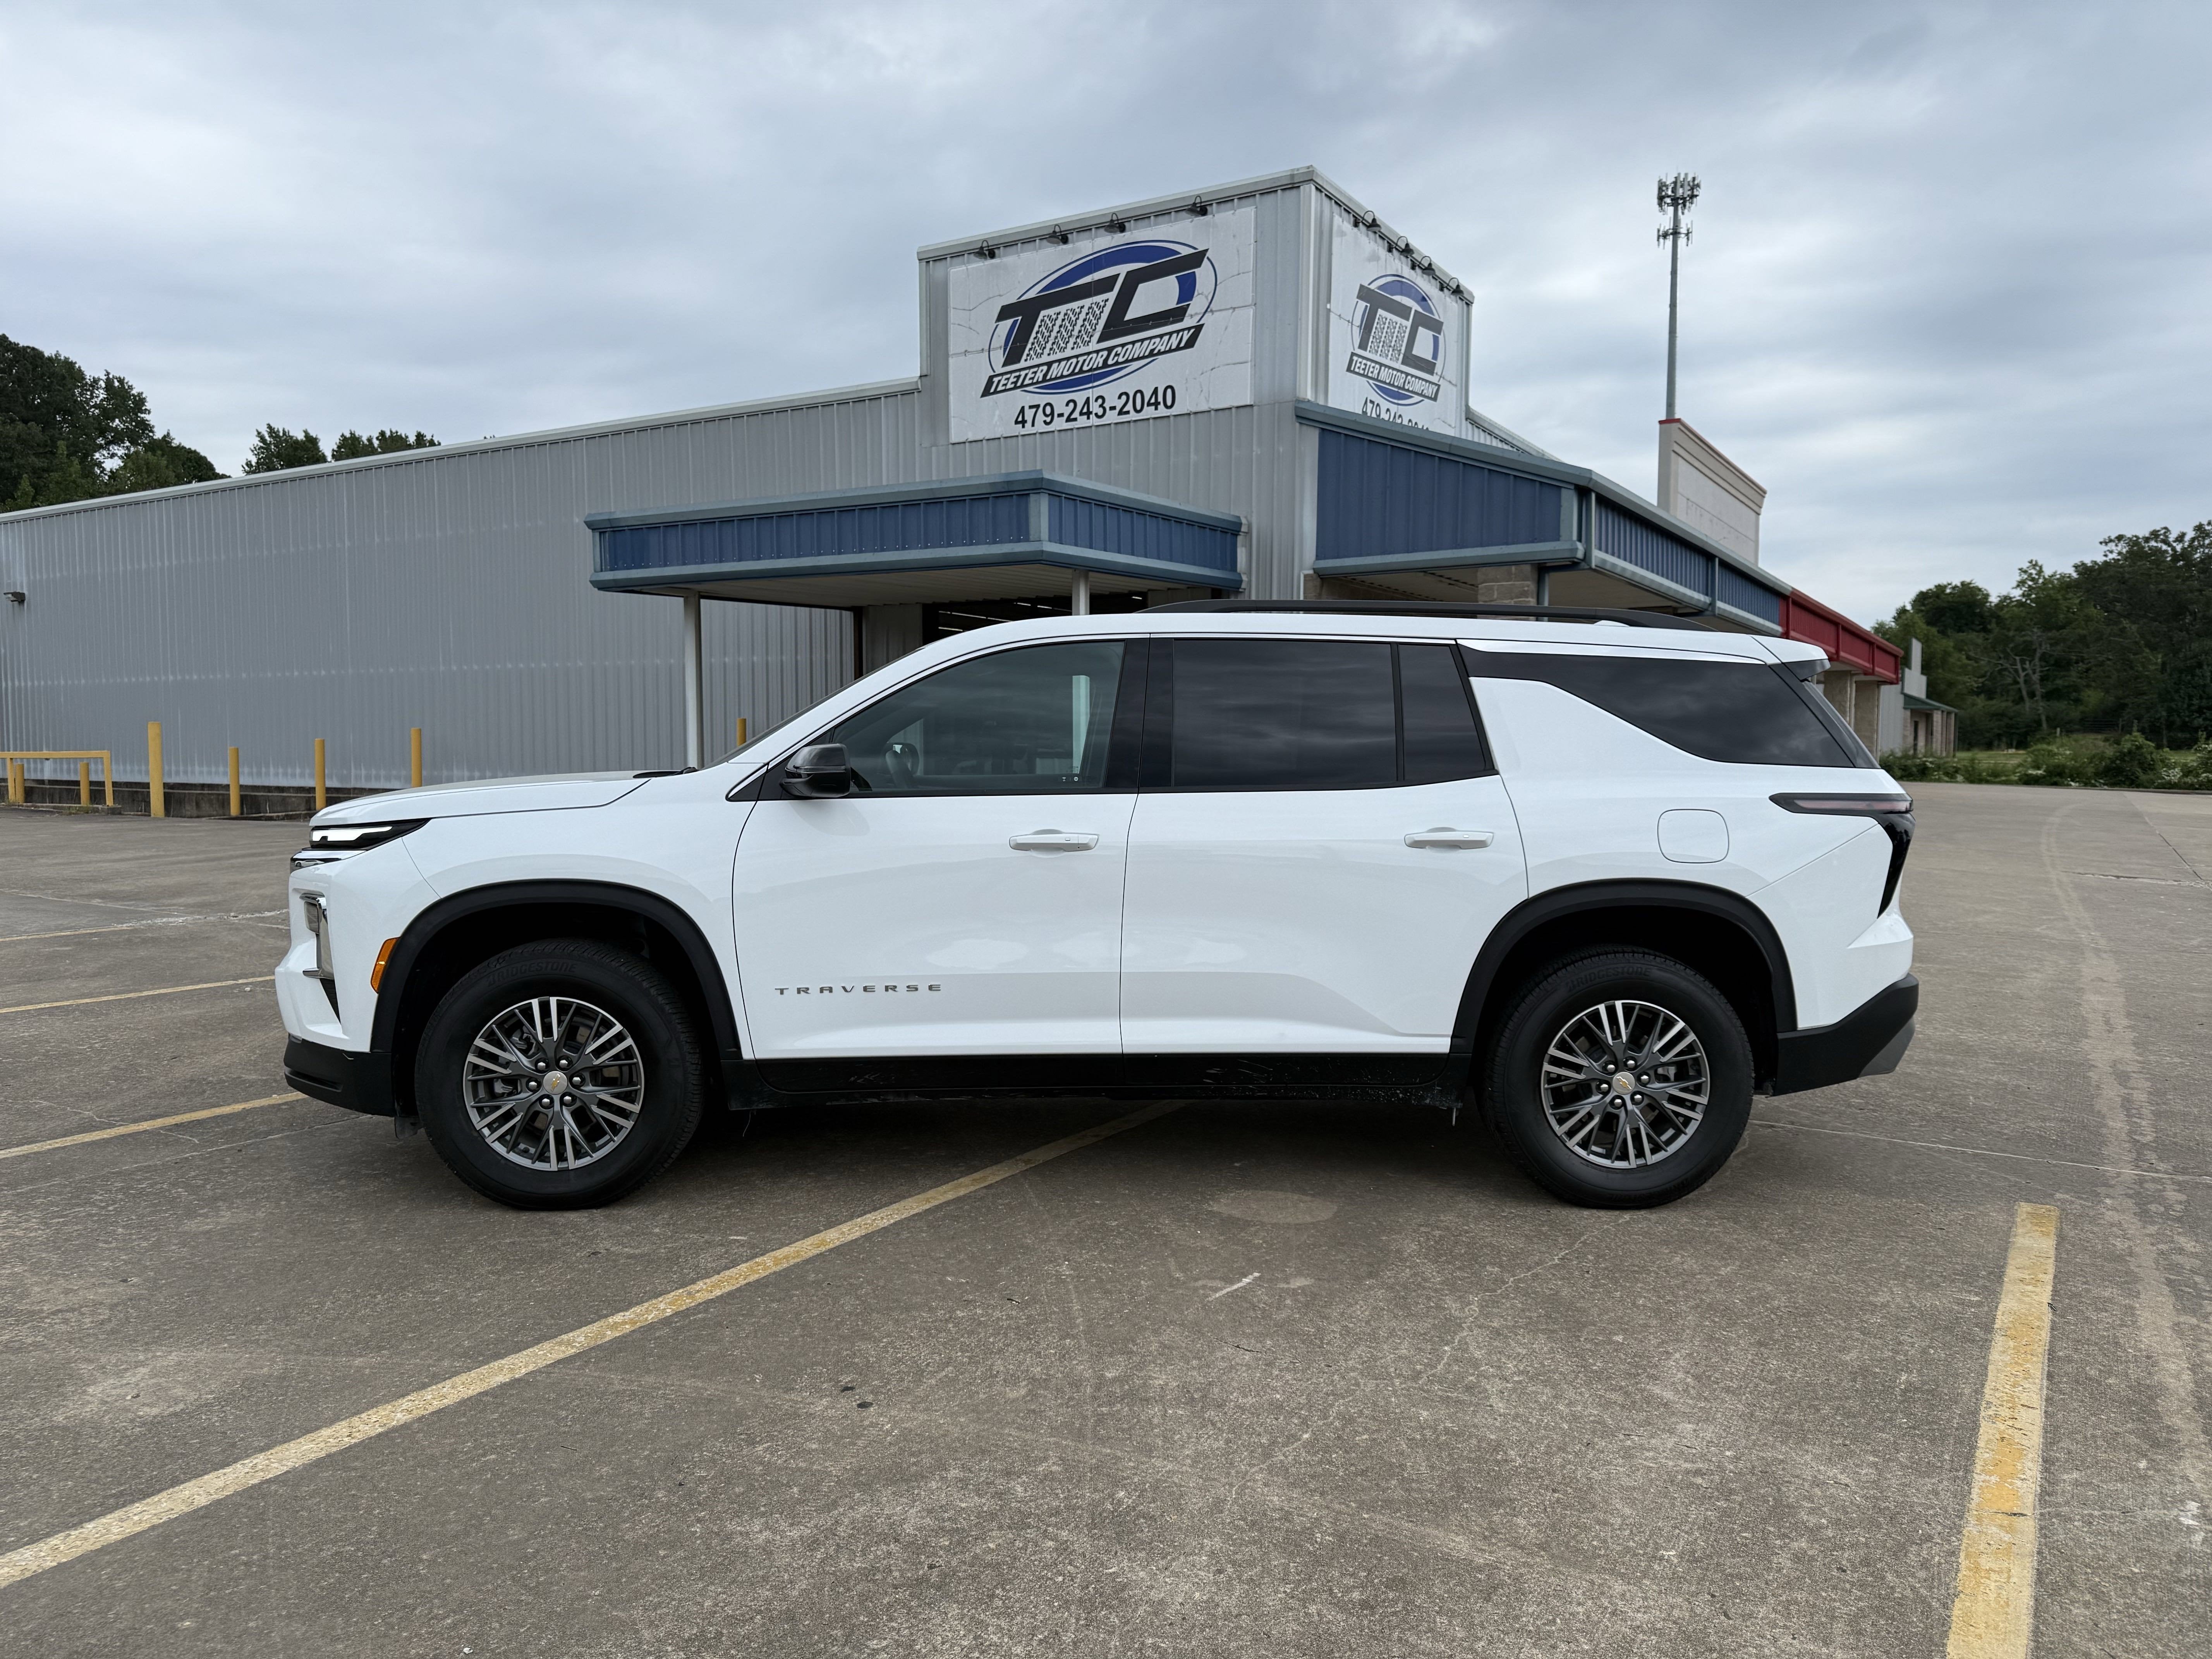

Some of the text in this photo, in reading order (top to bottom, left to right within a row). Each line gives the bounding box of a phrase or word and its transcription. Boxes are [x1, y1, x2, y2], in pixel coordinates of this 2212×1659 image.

[989, 328, 1195, 393] TEETER MOTOR COMPANY
[1351, 356, 1438, 398] TEETER MOTOR COMPANY
[1014, 385, 1176, 428] 479-243-2040
[486, 962, 577, 987] BRIDGESTONE
[775, 984, 941, 995] TRAVERSE
[1566, 966, 1651, 991] BRIDGESTONE
